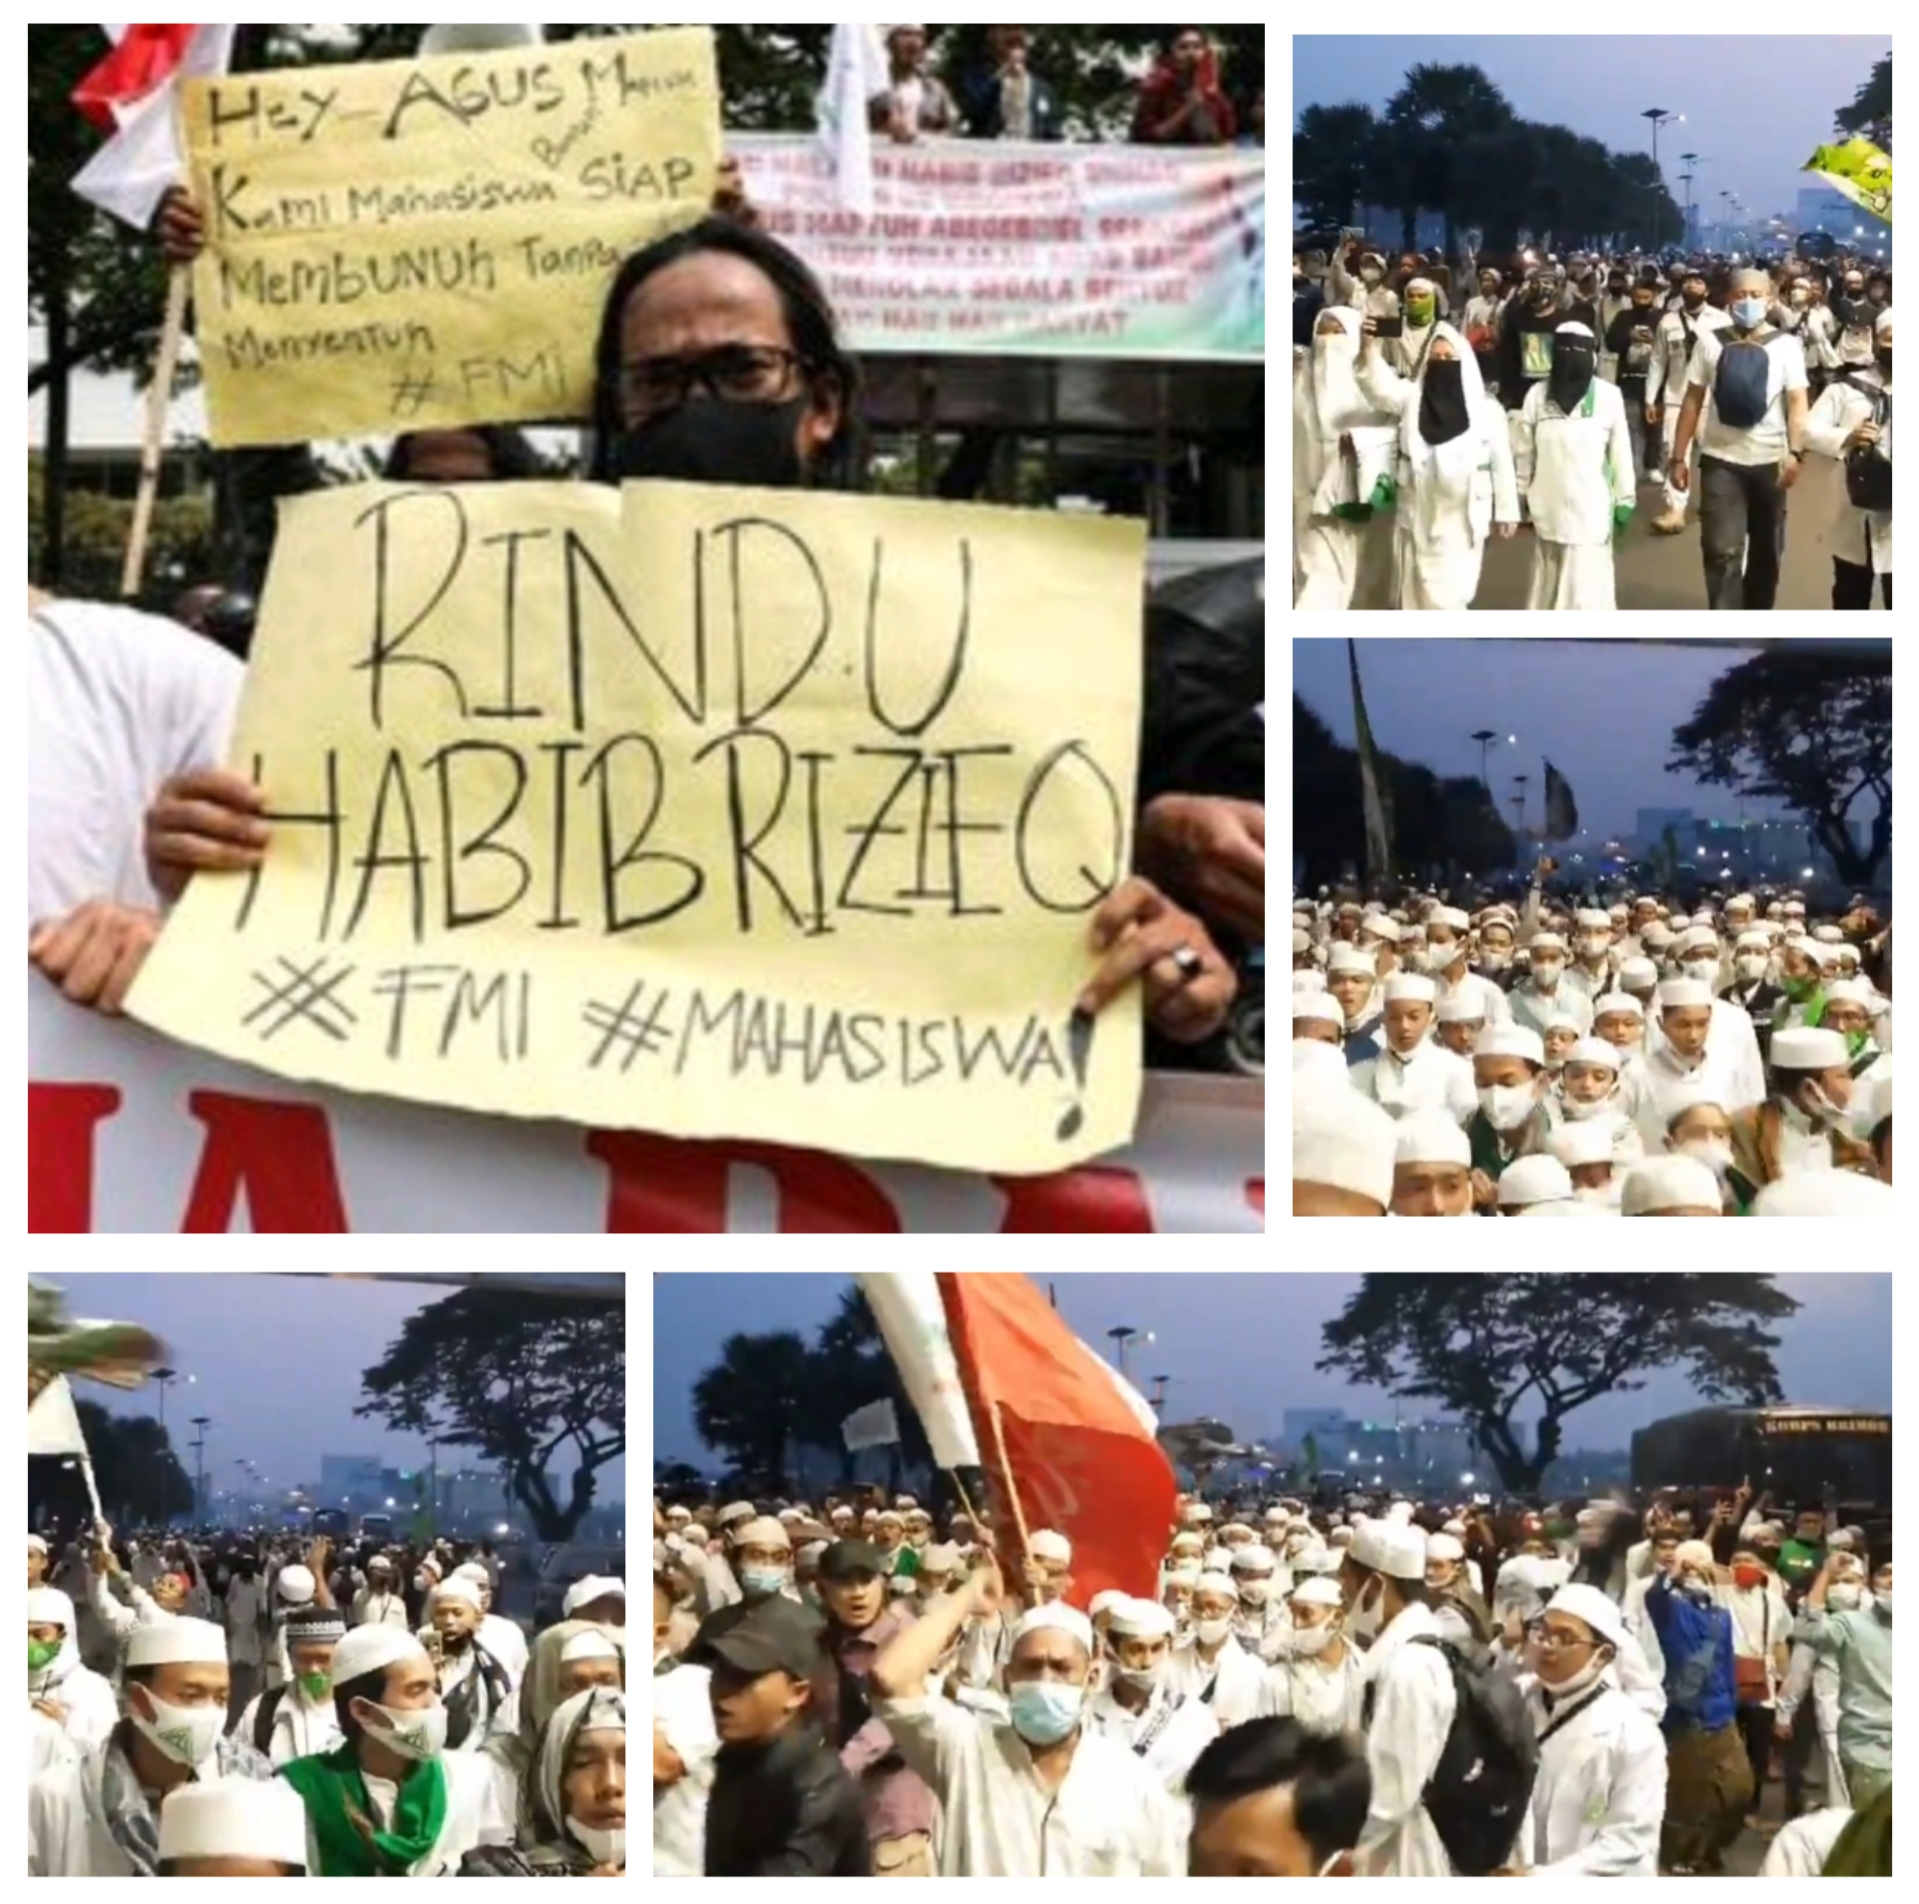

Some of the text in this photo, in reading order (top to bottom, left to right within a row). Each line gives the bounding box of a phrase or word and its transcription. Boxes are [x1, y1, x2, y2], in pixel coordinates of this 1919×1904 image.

[382, 64, 564, 139] AGUS
[353, 489, 972, 737] RINDU
[236, 729, 1124, 942] HABIB RIZIEQ
